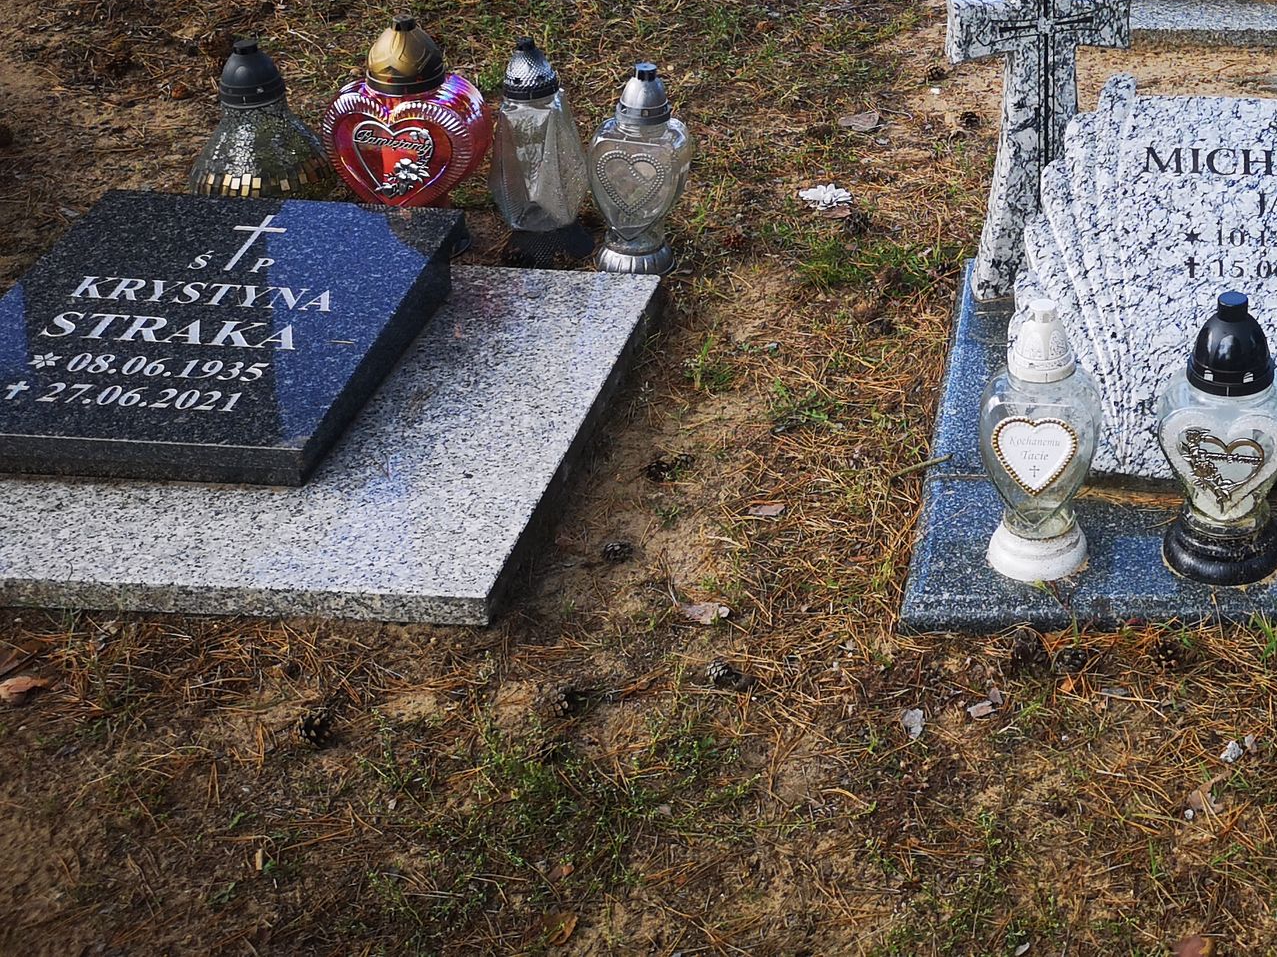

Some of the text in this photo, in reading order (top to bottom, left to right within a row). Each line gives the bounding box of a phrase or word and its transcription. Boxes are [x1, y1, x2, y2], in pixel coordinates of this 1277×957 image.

[250, 257, 275, 273] P
[69, 275, 331, 312] KRYSTYNA
[37, 311, 296, 350] STRAKA
[66, 352, 270, 382] 08.06.1935
[35, 382, 243, 412] 27.06.2021
[1022, 451, 1049, 461] Tacie
